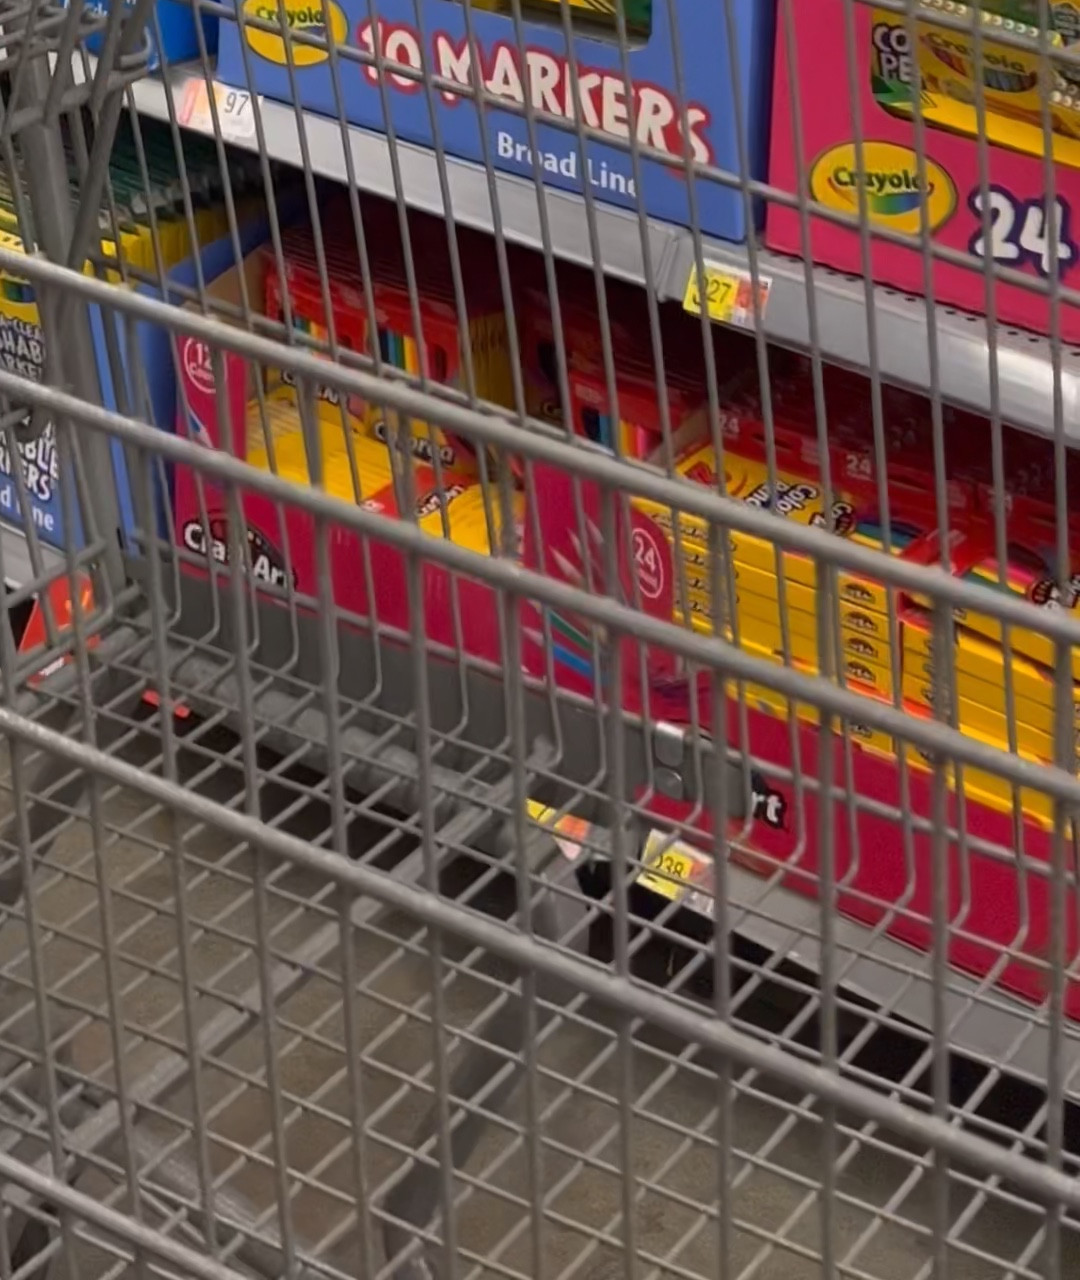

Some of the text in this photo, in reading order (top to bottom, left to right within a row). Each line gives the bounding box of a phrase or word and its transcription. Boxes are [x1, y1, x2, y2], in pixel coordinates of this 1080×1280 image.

[255, 4, 710, 166] Cryola 10 MARKERS
[497, 130, 577, 179] Broad
[974, 190, 1072, 274] 24
[632, 535, 657, 573] 24
